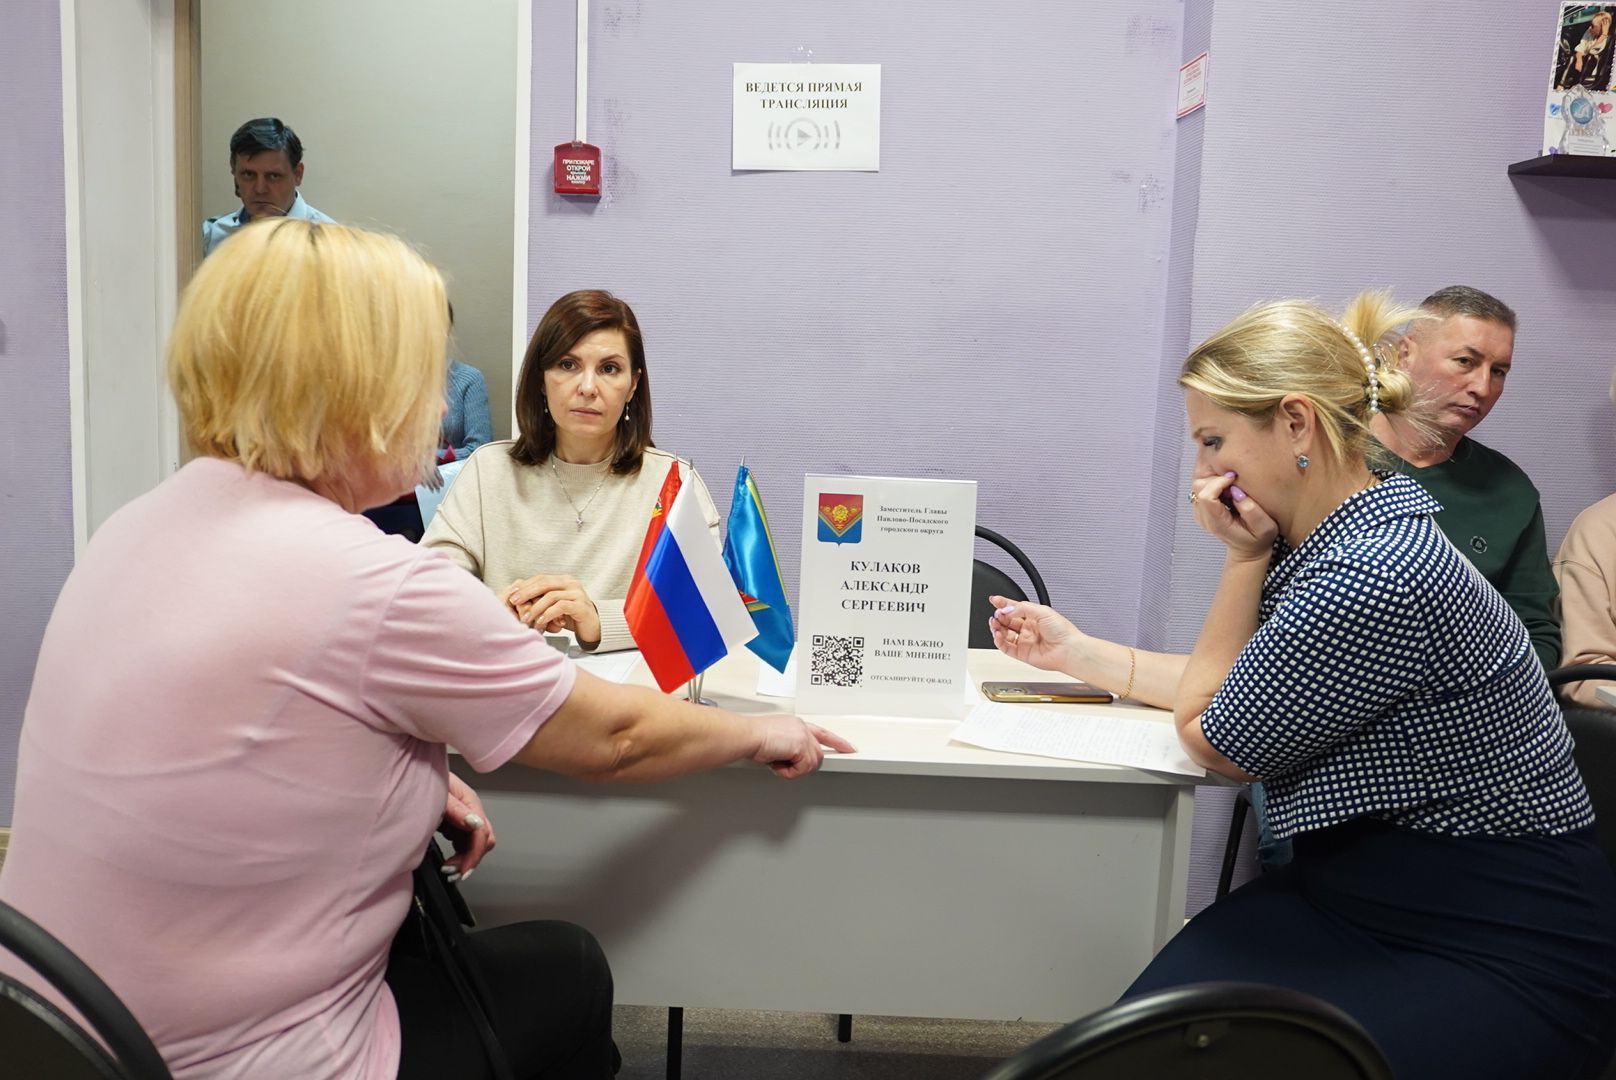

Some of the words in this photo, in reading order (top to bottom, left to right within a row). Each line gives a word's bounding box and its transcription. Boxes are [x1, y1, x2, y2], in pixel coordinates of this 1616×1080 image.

[746, 82, 804, 93] ВЕДЕТСЯ
[808, 82, 862, 93] ПРЯМАЯ
[760, 98, 848, 110] ТРАНСЛЯЦИЯ
[880, 505, 922, 514] Заместитель
[877, 515, 949, 525] Павлово-Посадского
[880, 526, 918, 534] городского
[850, 561, 921, 573] КУЛАКОВ
[840, 580, 928, 594] АЛЕКСАНДР
[841, 599, 926, 613] СЕРГЕЕВИЧ
[883, 638, 905, 647] НАМ
[908, 639, 944, 648] ВАЖНО
[874, 650, 903, 658] ВАШЕ
[905, 651, 951, 661] МНЕНИЕ!
[870, 675, 925, 683] ОТСКАНИРУЙТЕ
